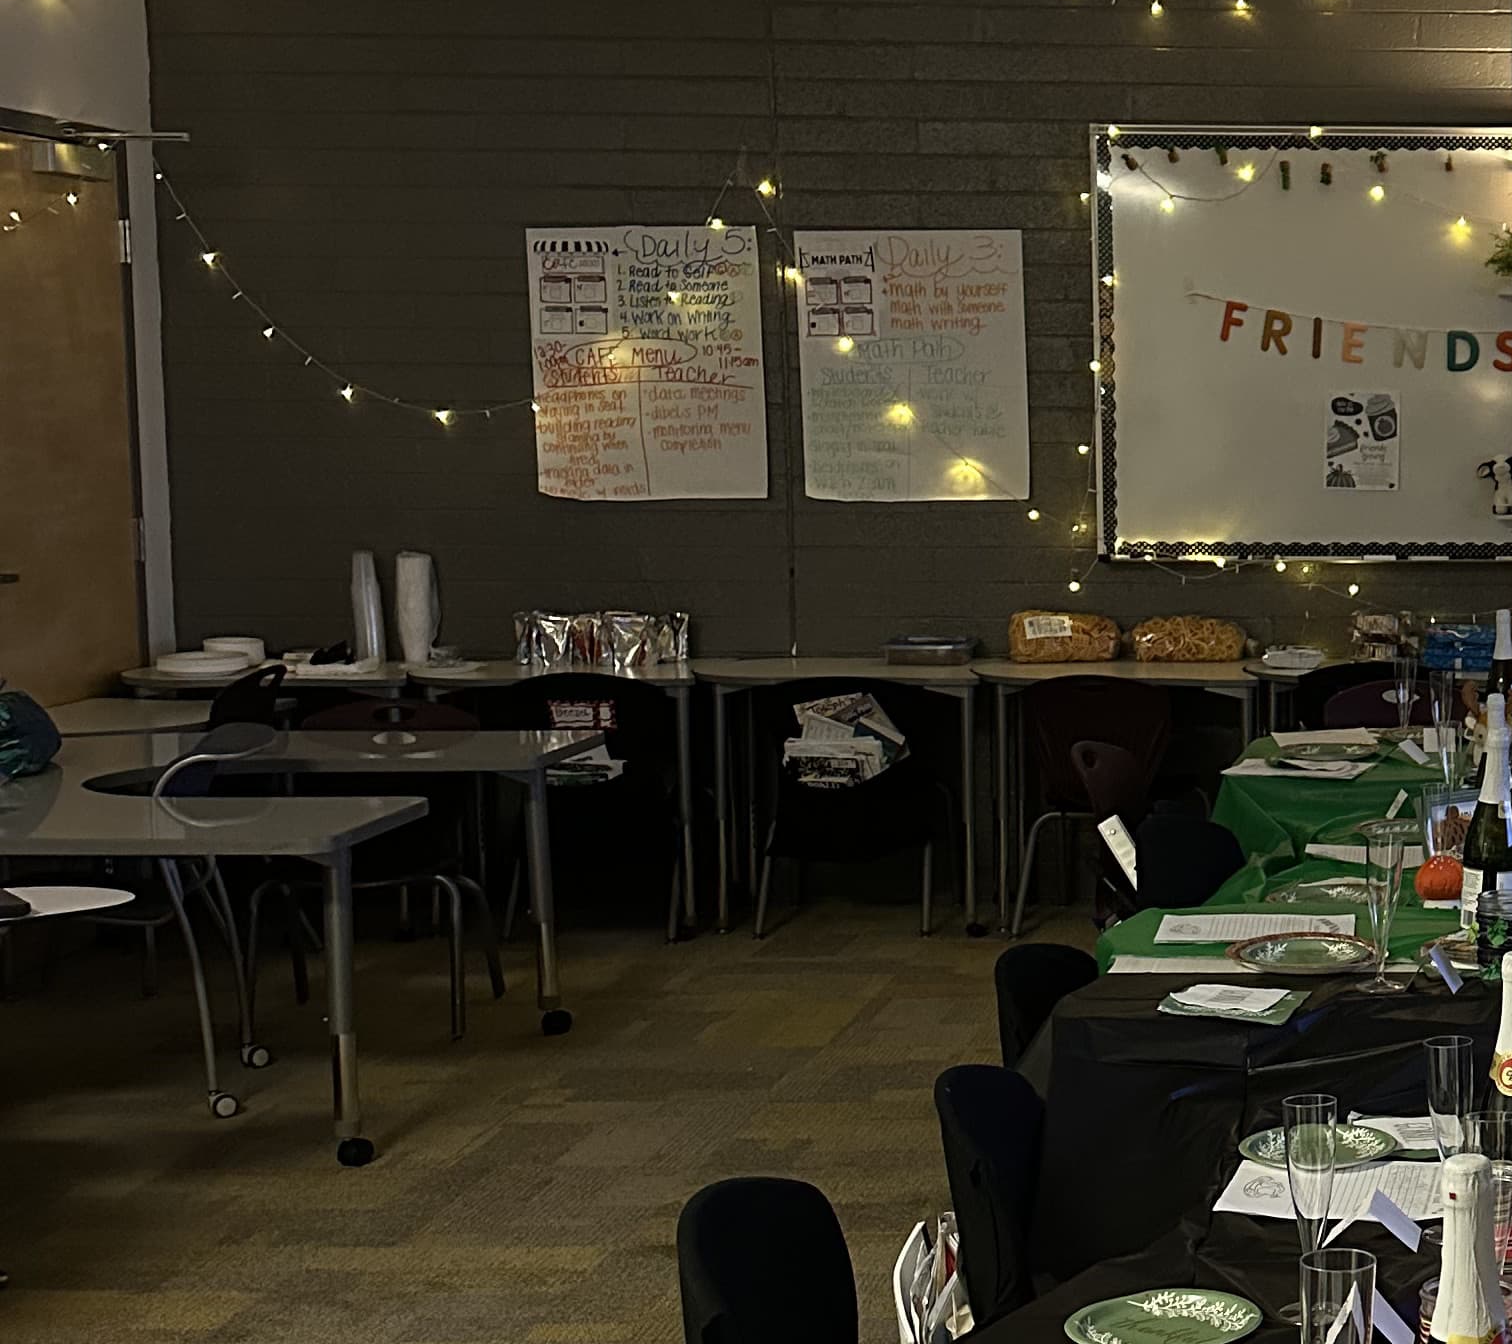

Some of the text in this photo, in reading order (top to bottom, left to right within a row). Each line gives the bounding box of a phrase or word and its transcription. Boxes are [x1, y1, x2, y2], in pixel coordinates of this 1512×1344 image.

[641, 230, 711, 263] Daily
[811, 254, 863, 266] MATH PATH
[887, 236, 964, 280] Daily
[629, 265, 661, 279] Read
[665, 266, 679, 278] to
[629, 280, 662, 292] Read
